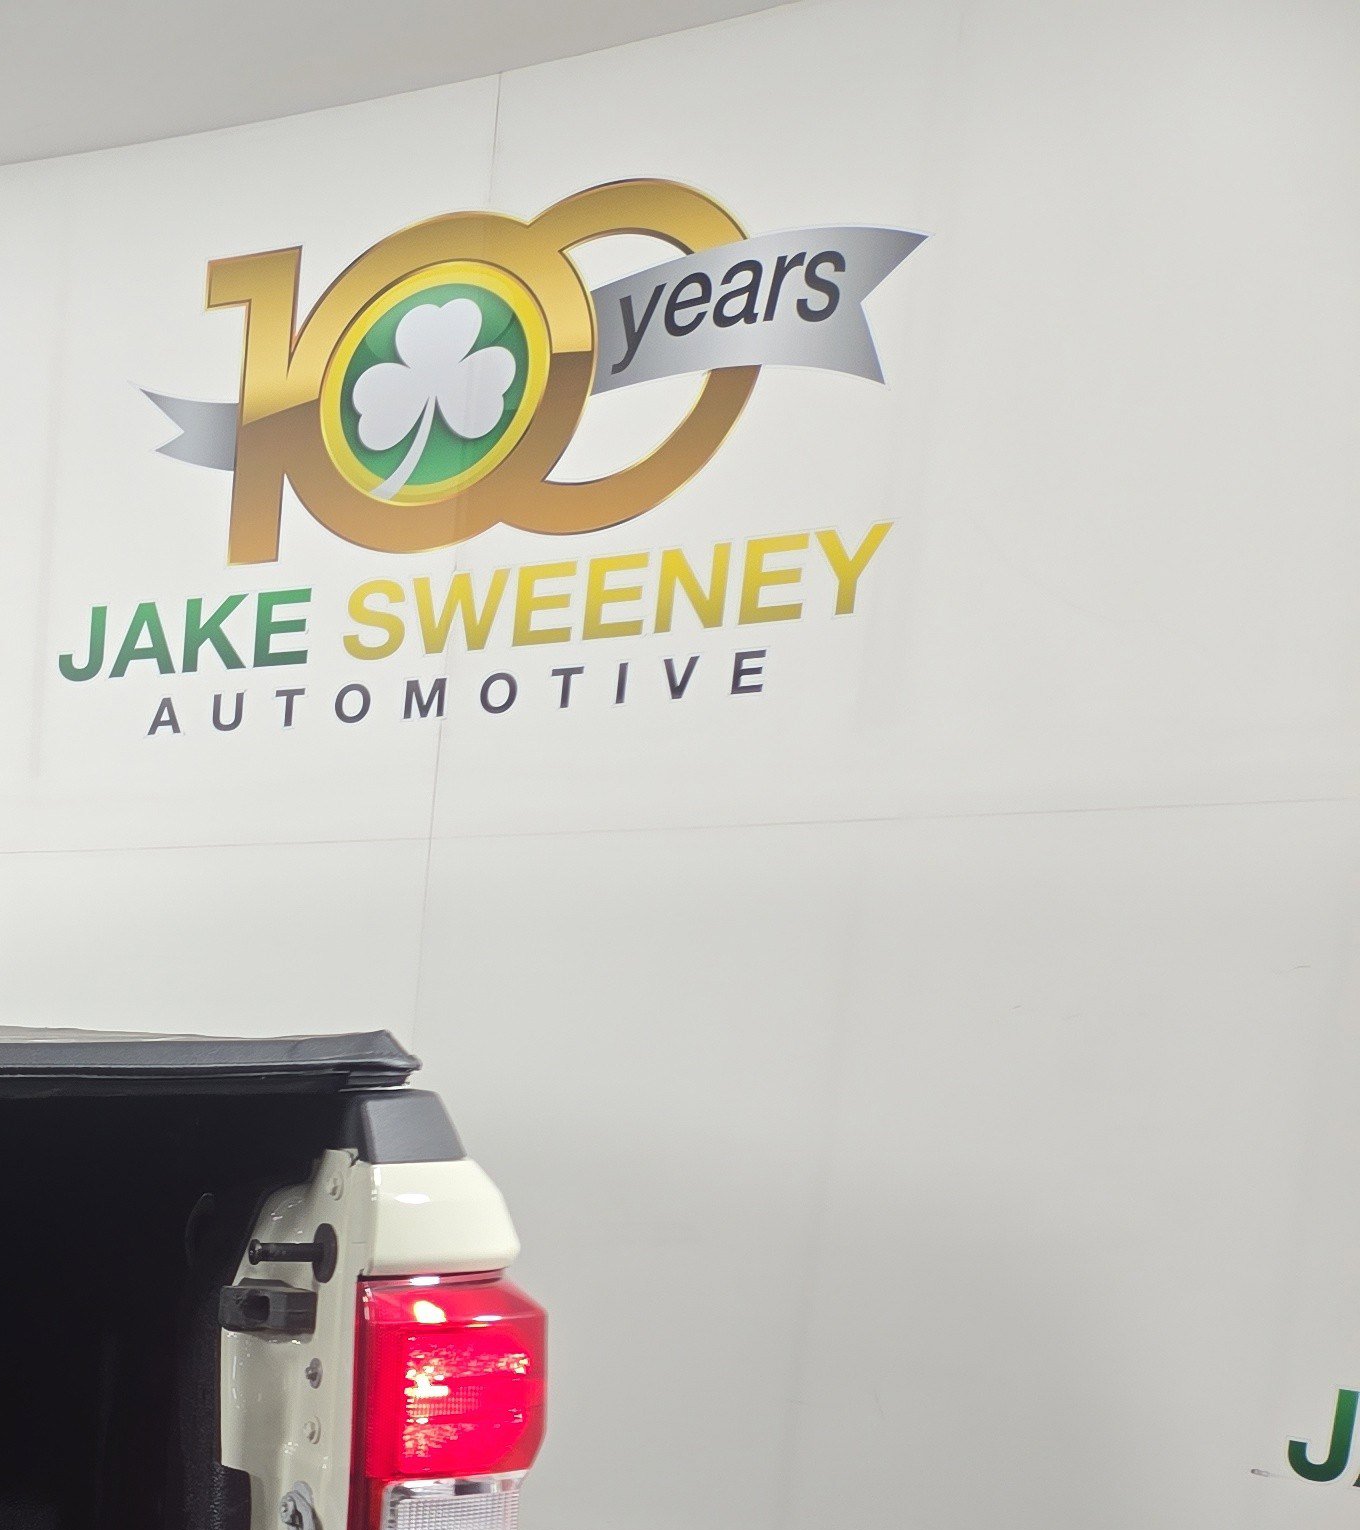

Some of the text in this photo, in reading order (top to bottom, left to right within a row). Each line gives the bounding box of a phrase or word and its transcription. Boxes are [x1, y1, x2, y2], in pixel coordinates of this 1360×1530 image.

[612, 250, 847, 375] years
[57, 521, 895, 683] JAKE SWEENEY
[146, 648, 771, 737] AUTOMOTIVE
[1287, 1388, 1360, 1487] J
